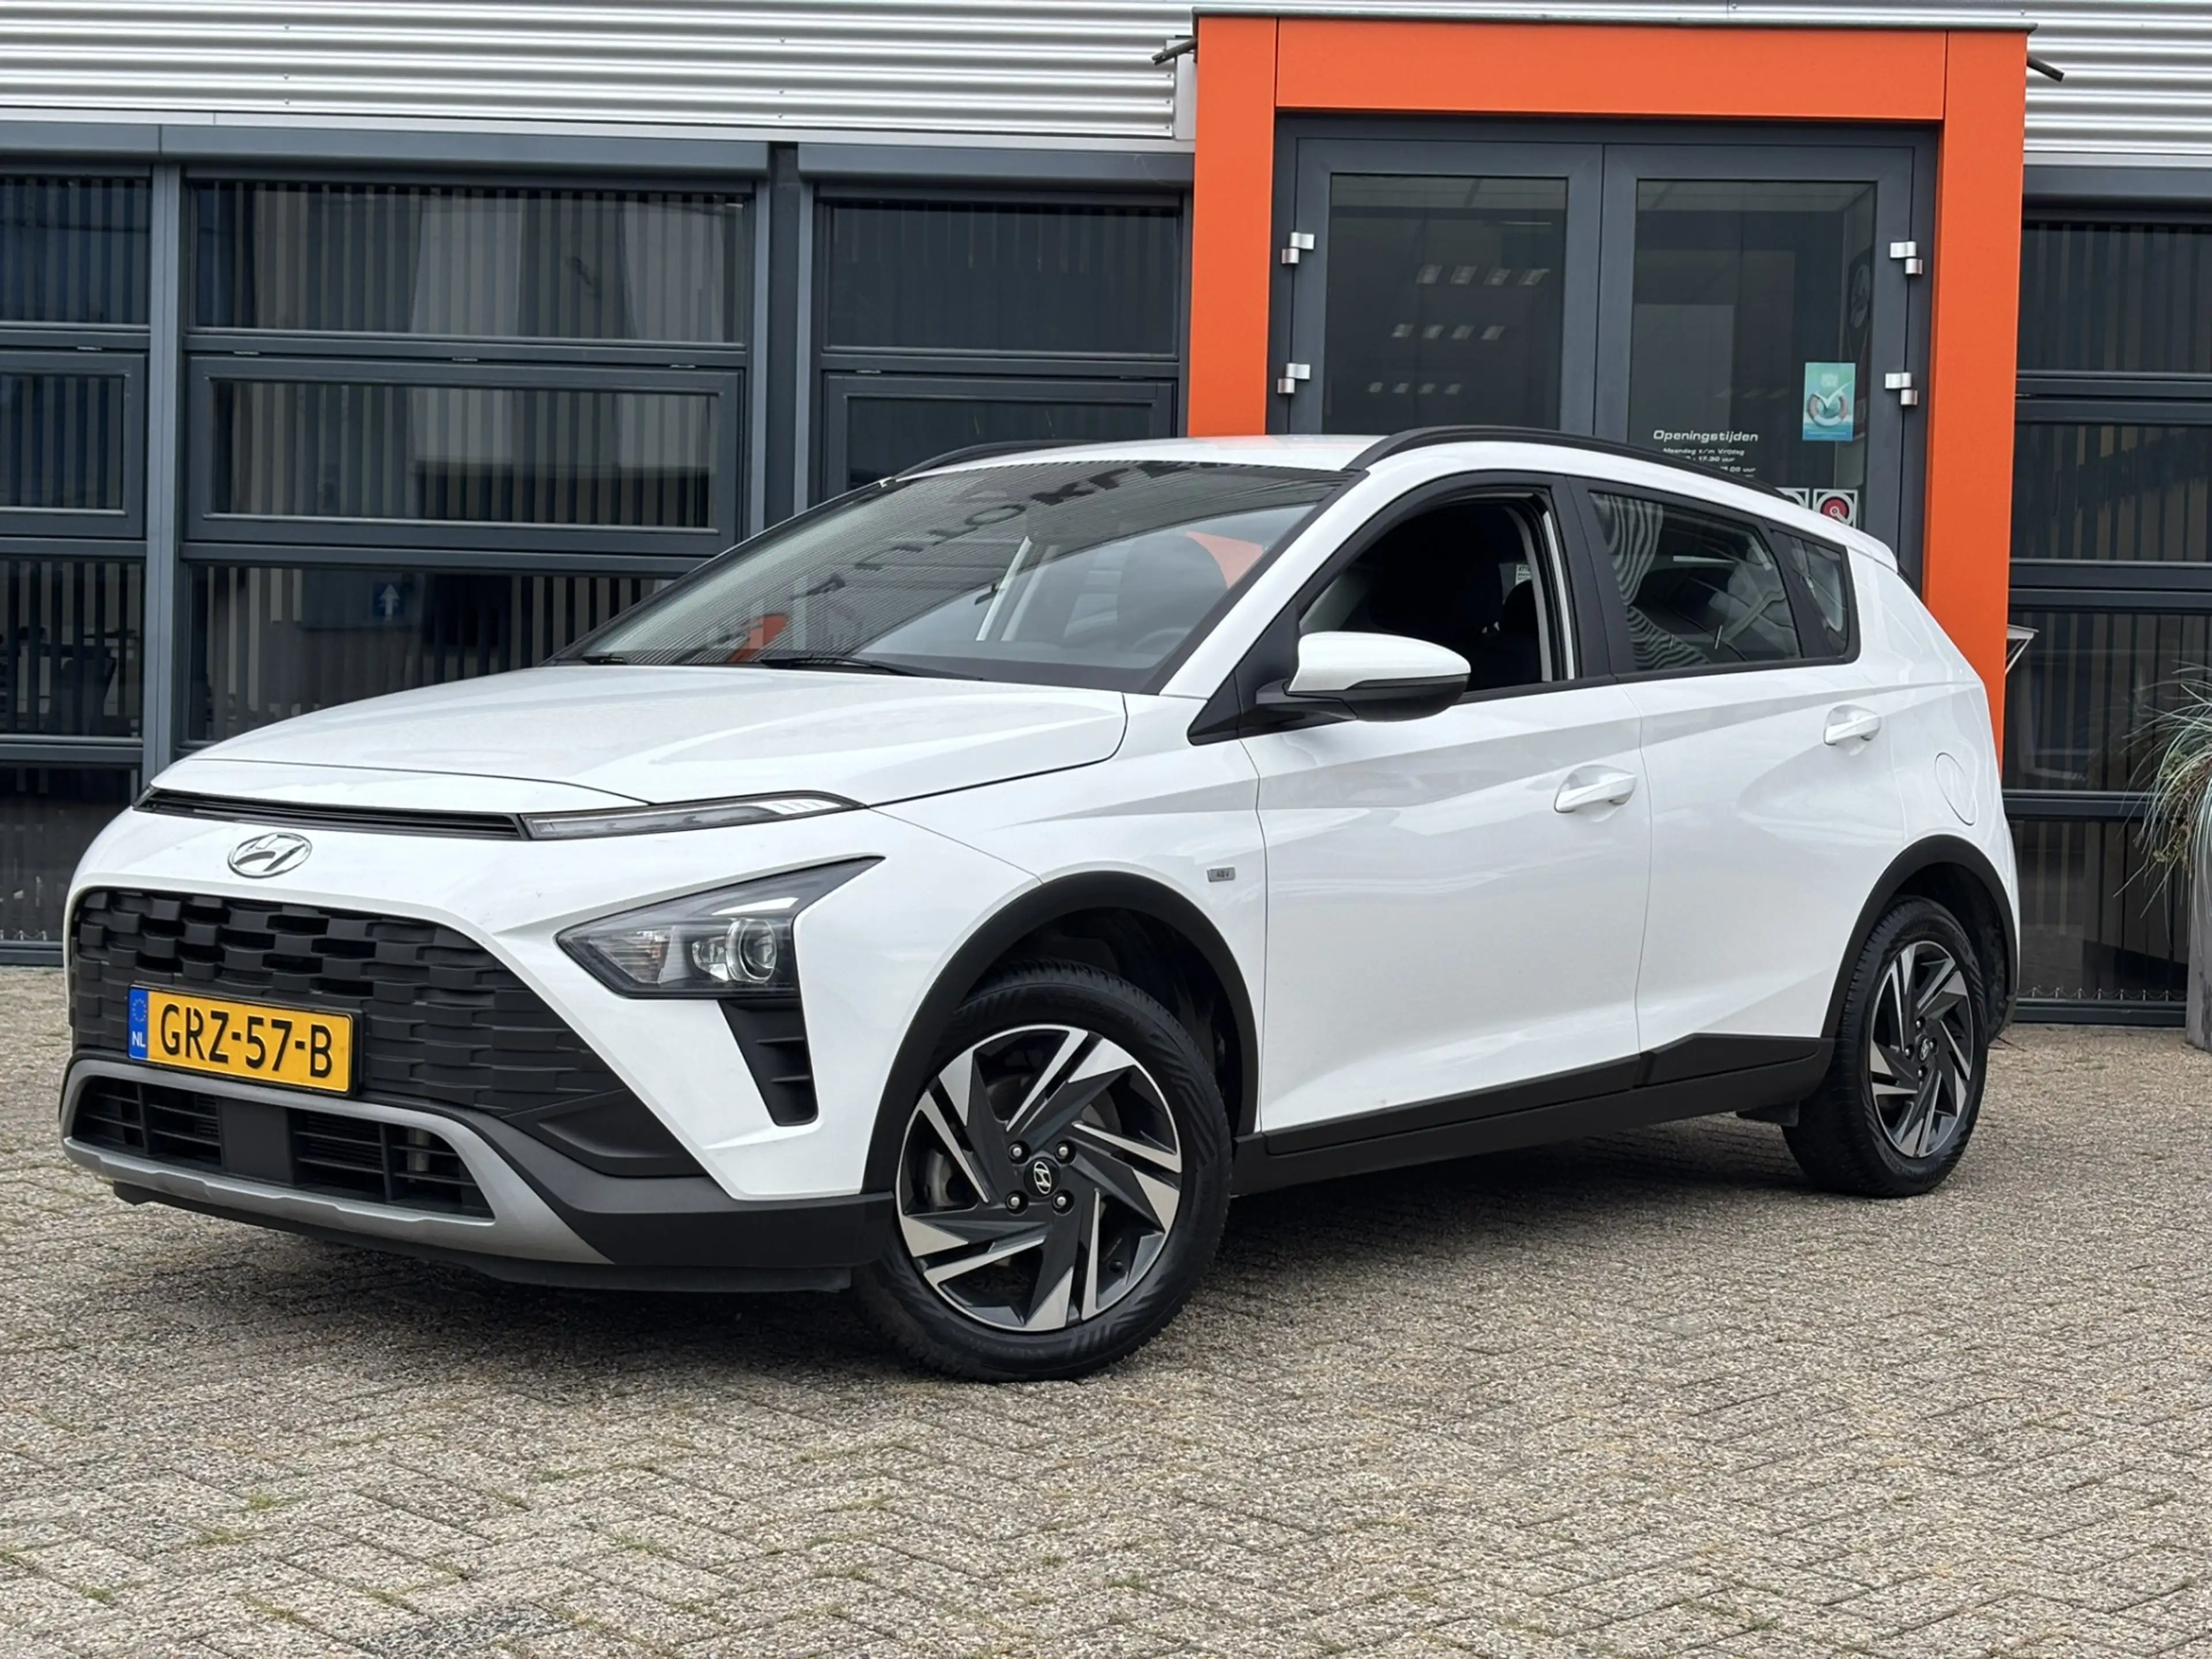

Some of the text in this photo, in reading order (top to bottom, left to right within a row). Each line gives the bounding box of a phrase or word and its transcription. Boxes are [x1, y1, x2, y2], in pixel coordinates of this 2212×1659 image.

[1653, 430, 1759, 444] Openingstijden
[131, 1003, 333, 1079] NL GRZ-57-B
